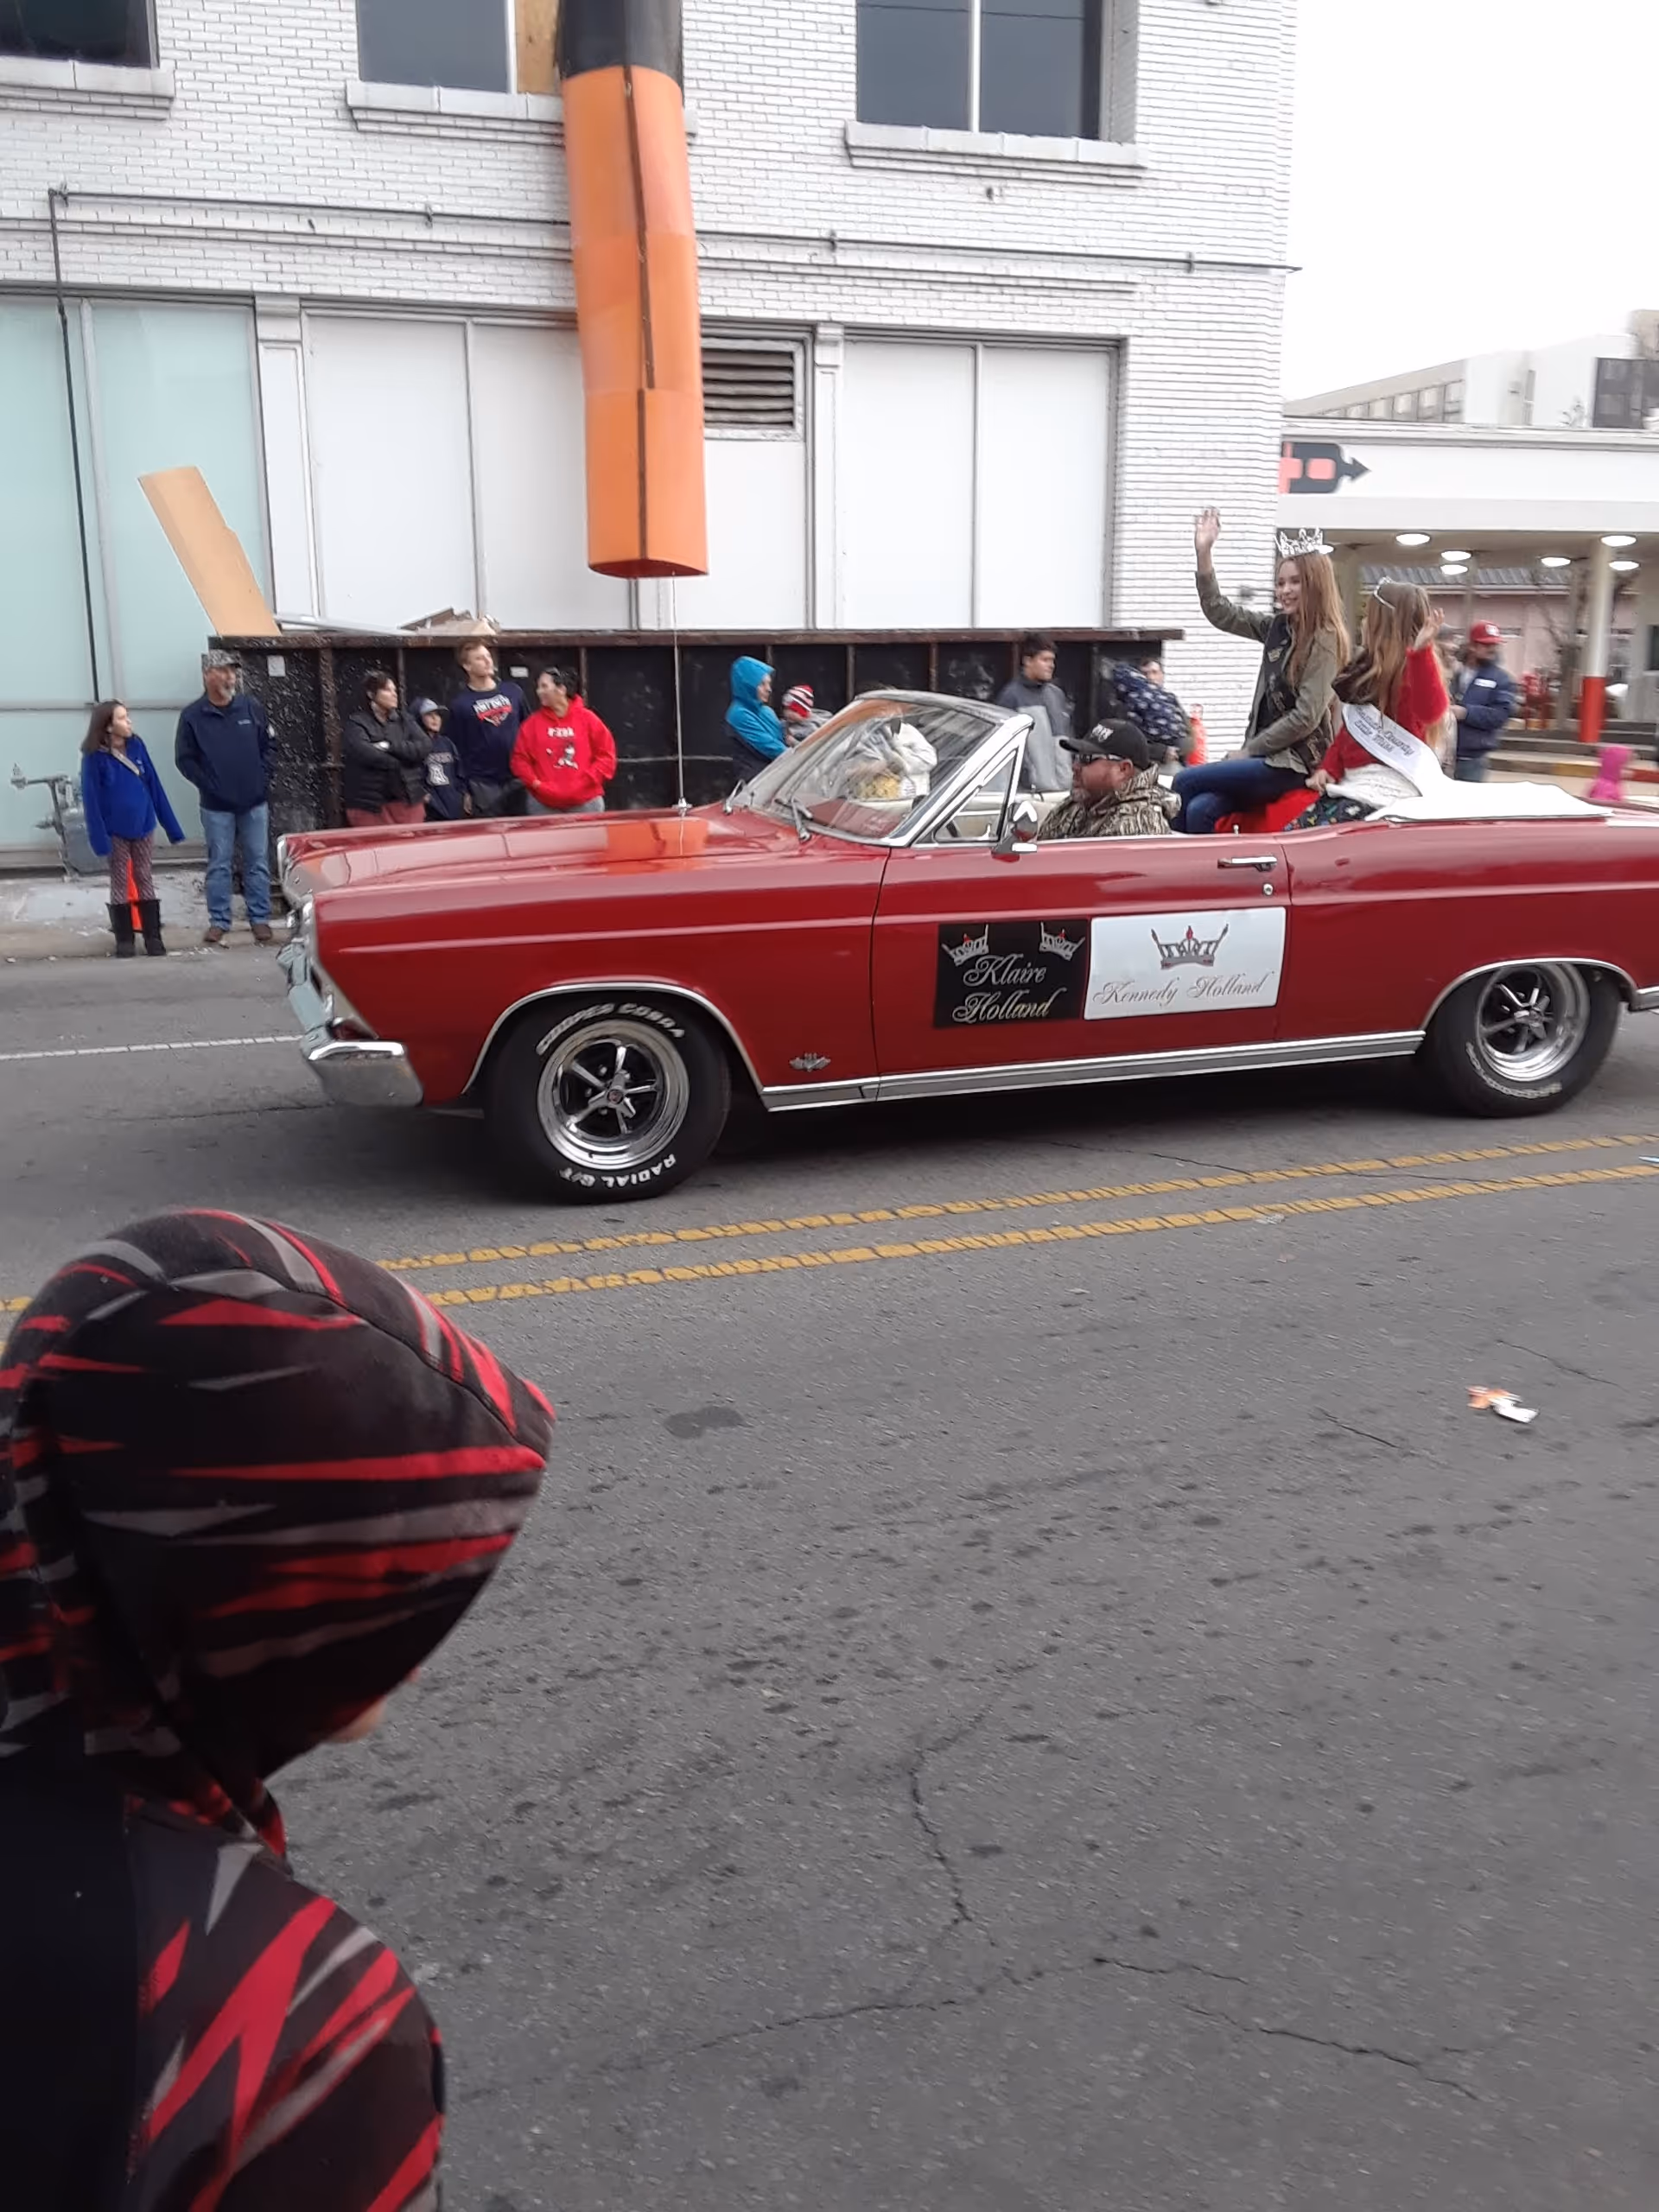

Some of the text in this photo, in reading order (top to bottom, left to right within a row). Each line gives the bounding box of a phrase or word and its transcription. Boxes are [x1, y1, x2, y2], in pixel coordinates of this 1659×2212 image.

[963, 953, 1047, 988] Klaire
[952, 988, 1066, 1023] Holland
[1092, 969, 1276, 1008] Kennedy Holland
[601, 1154, 677, 1188] RADIAL
